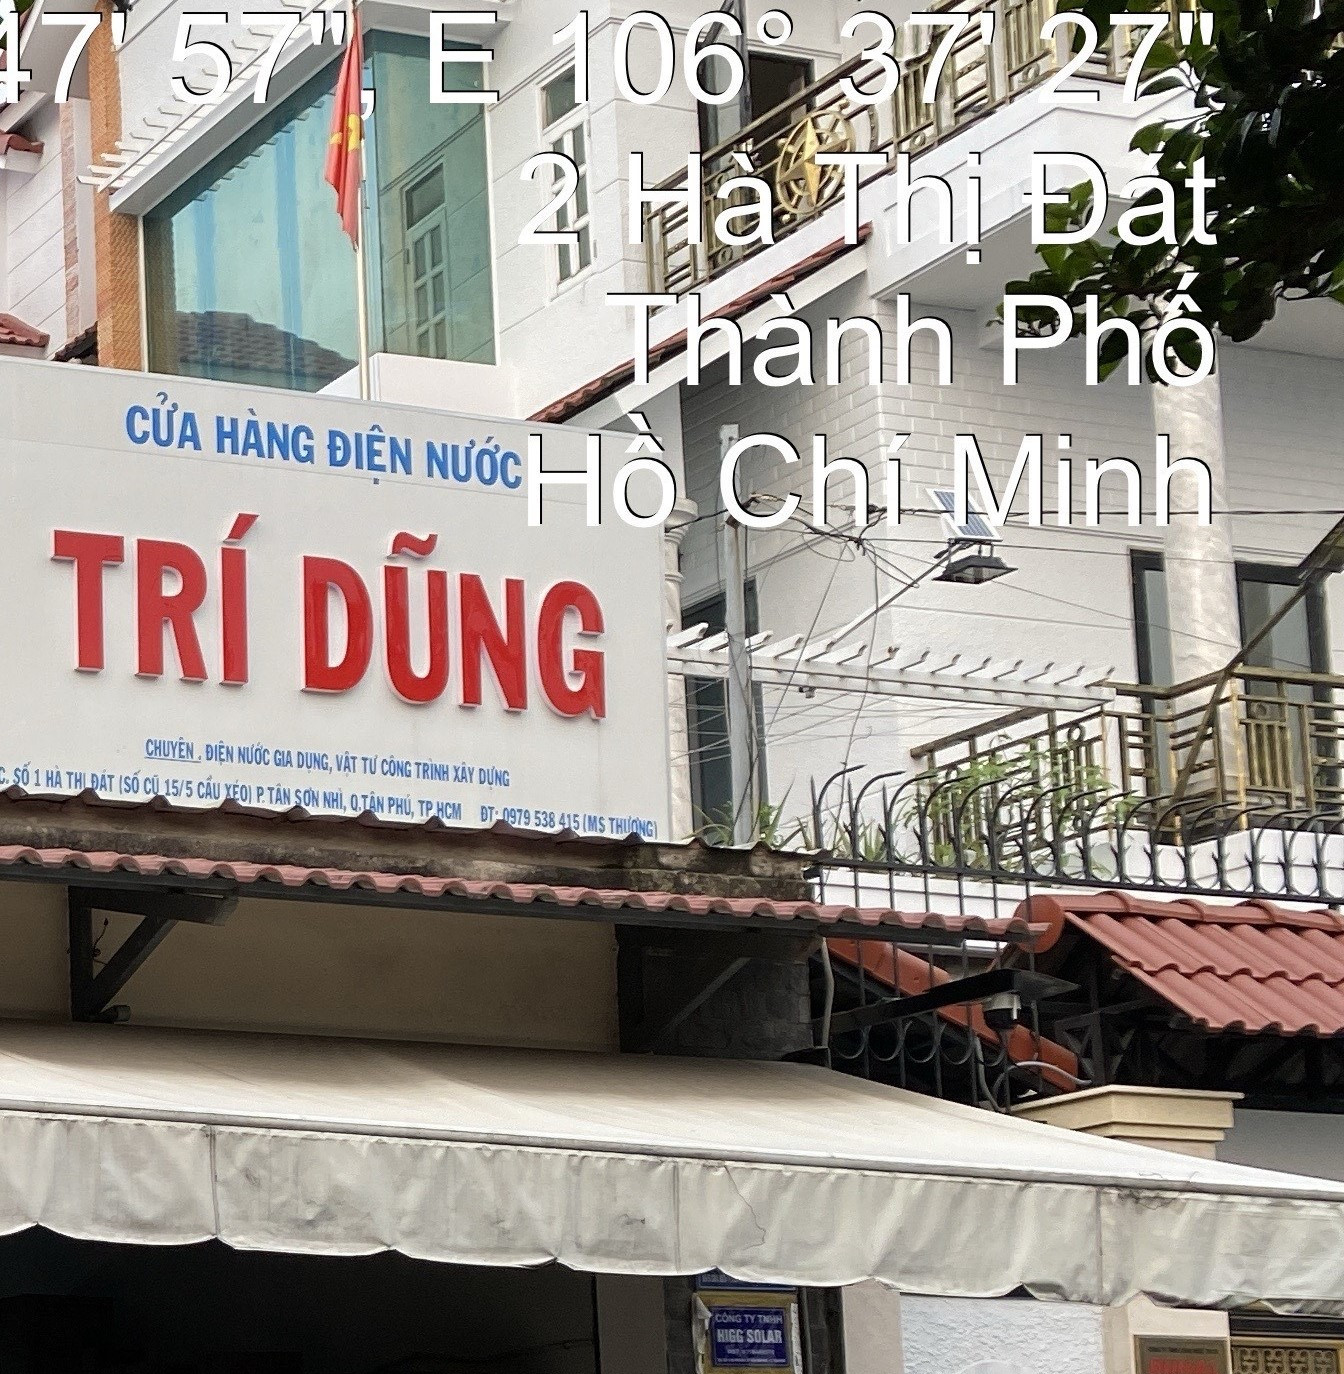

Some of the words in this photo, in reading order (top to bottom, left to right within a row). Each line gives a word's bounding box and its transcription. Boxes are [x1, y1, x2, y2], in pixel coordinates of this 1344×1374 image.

[126, 391, 202, 452] CỬA
[215, 406, 314, 464] HÀNG
[327, 429, 412, 485] ĐIỆN
[426, 435, 523, 490] NƯỚC
[51, 513, 260, 687] TRÍ
[301, 532, 607, 721] DŨNG
[13, 761, 31, 786] SỐ
[34, 769, 41, 787] 1
[46, 765, 62, 789] HÀ
[143, 773, 160, 795] CŨ
[164, 778, 193, 798] 15/5
[197, 774, 221, 801] CẦU
[294, 787, 320, 808] SƠN
[502, 807, 530, 827] 0979
[534, 810, 556, 829] 538
[558, 813, 580, 832] 415
[145, 737, 194, 759] CHUYÊN
[205, 740, 233, 765] ĐIỆN
[238, 742, 270, 766] NƯỚC
[274, 749, 293, 767] GIA
[297, 751, 332, 774] DỤNG,
[335, 751, 357, 777] VẬT
[361, 754, 378, 775] TƯ
[381, 755, 412, 778] CÔNG
[414, 757, 449, 782] TRÌNH
[453, 761, 475, 784] XÂY
[478, 766, 510, 791] DỰNG
[746, 1329, 783, 1344] SOLAR
